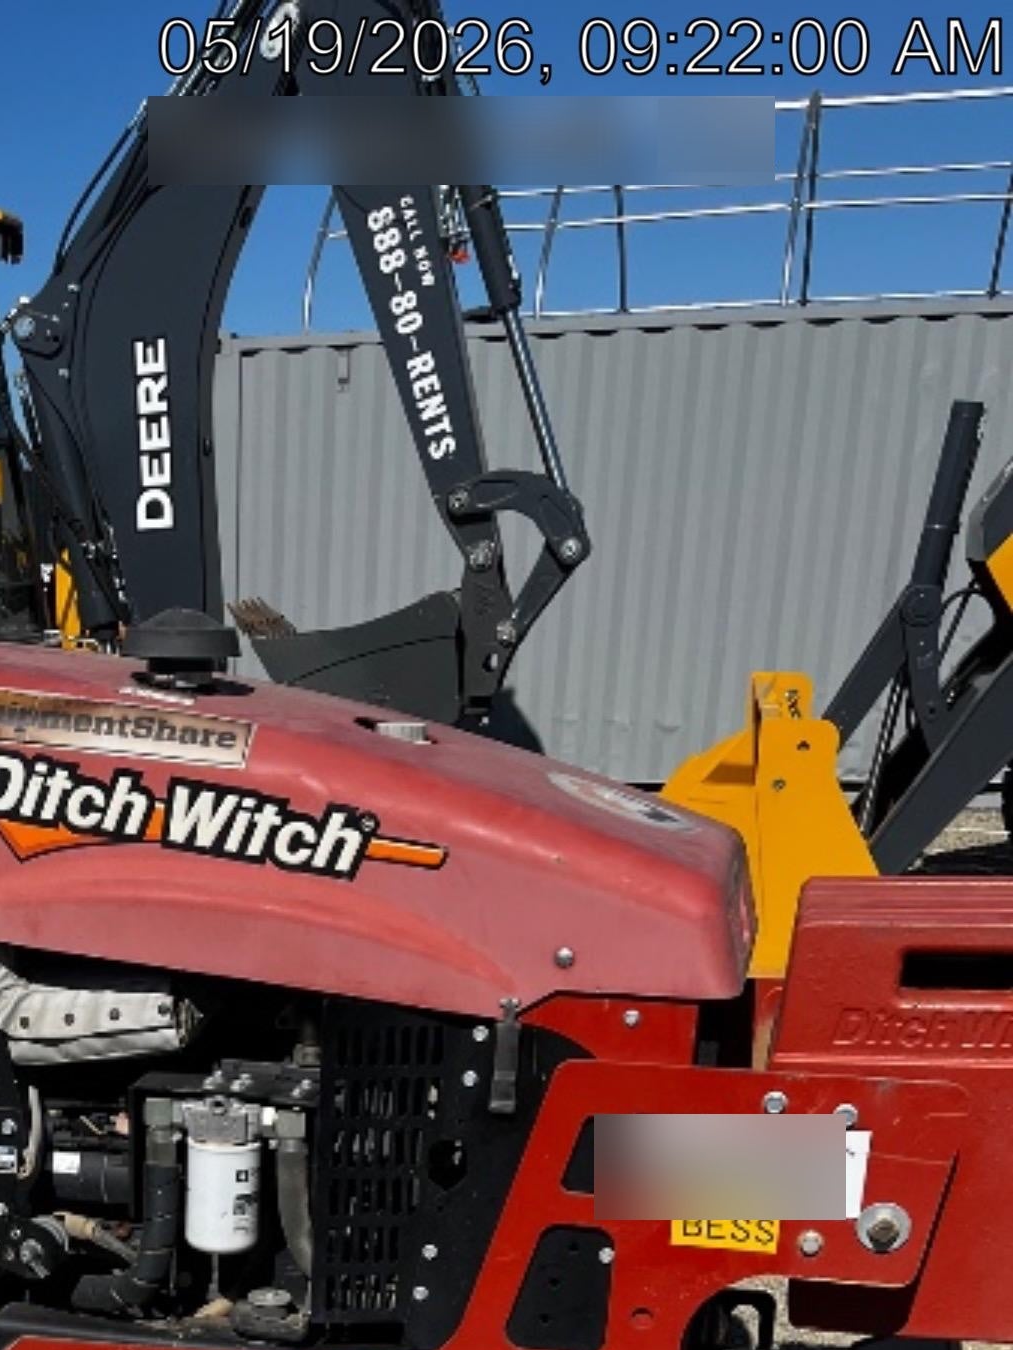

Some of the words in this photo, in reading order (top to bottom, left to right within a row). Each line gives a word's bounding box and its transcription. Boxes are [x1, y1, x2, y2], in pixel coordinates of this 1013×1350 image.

[400, 195, 423, 241] CALL
[414, 245, 436, 287] NOW
[368, 206, 456, 460] 888-80-RENTS
[133, 337, 175, 532] DEERE
[165, 785, 363, 874] Witch
